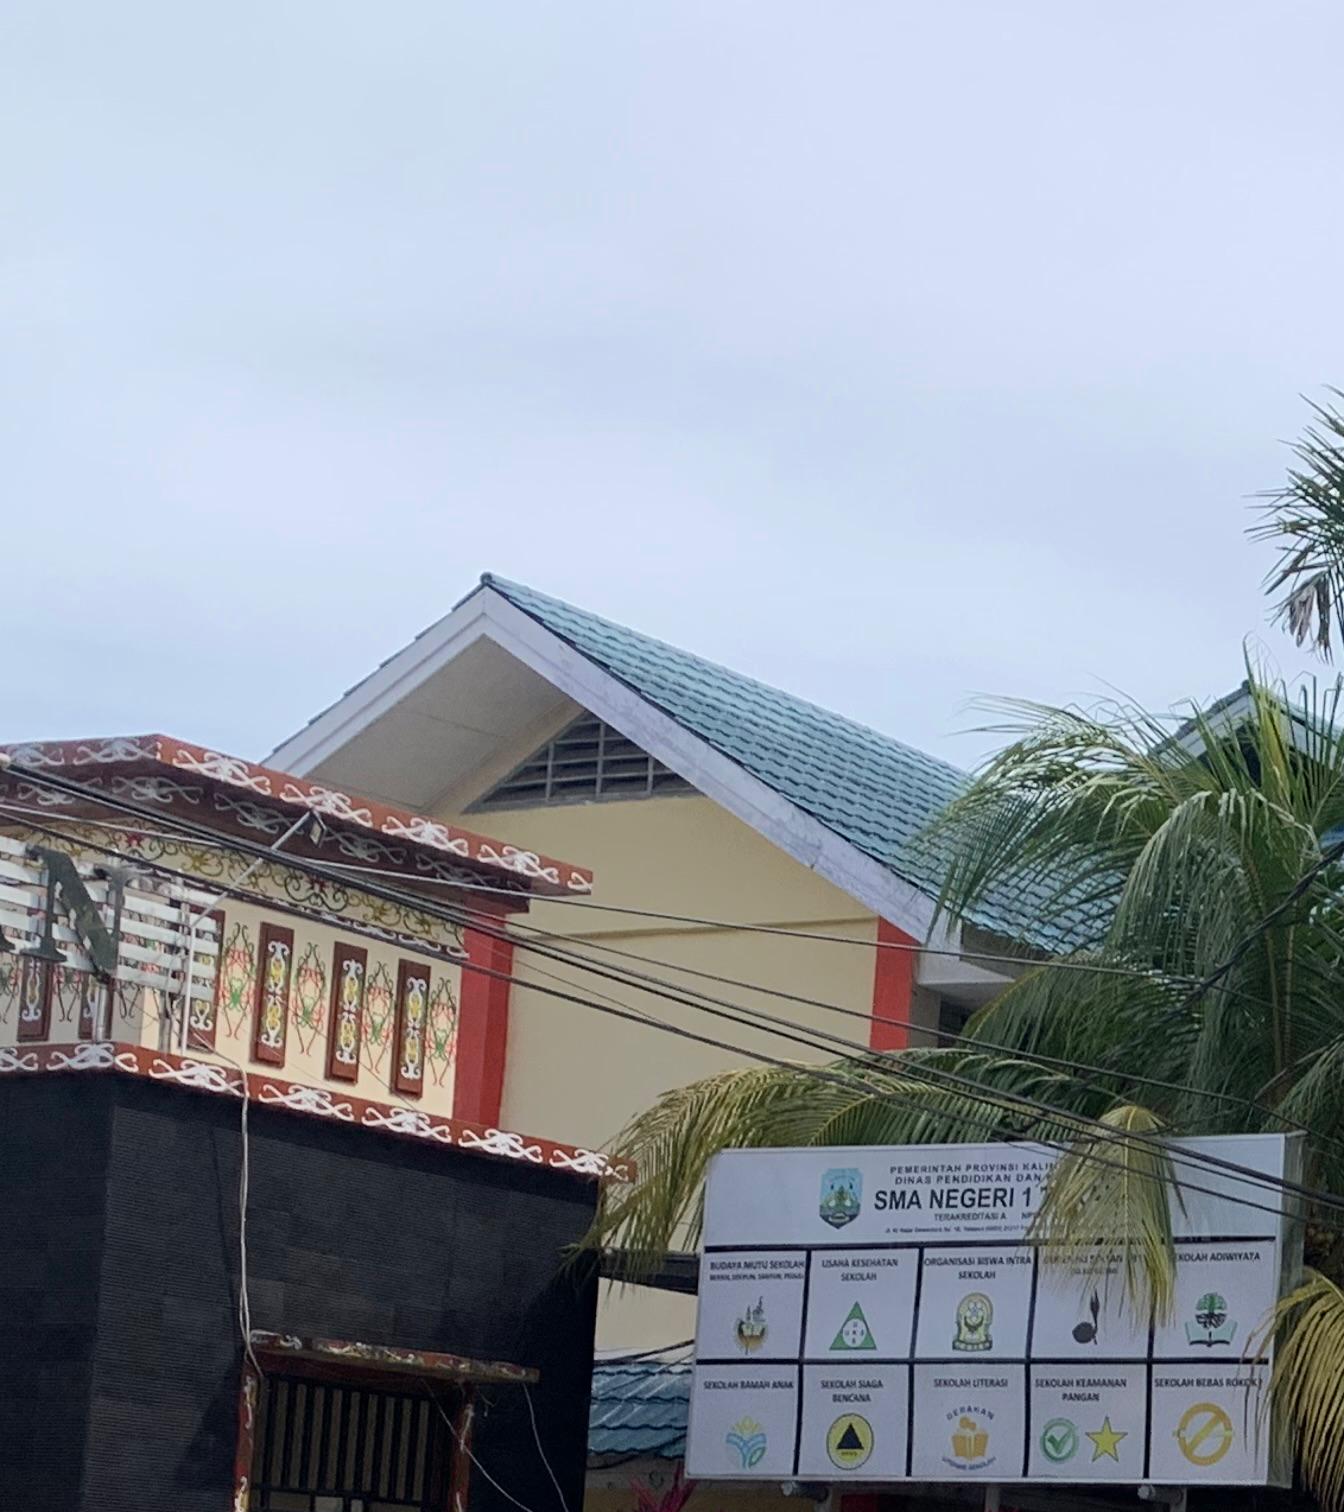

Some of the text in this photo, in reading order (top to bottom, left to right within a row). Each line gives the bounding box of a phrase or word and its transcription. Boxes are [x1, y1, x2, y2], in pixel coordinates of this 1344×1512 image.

[890, 1164, 962, 1174] PEMERINTAH
[965, 1163, 1018, 1172] PROVINSI
[895, 1174, 1041, 1185] DINAS PENDIDIKAN DAN
[874, 1187, 1031, 1210] SMA NEGERI 1
[1005, 1255, 1032, 1265] INTRA
[841, 1272, 877, 1282] SEKOLAH
[958, 1270, 996, 1280] SEKOLAH
[704, 1380, 738, 1389] SEKOLAH
[821, 1379, 857, 1389] SEKOLAH
[933, 1378, 1008, 1388] SEKOLAH LITERASI
[1035, 1378, 1127, 1388] SEKOLAH KEAMANAN
[1154, 1378, 1195, 1388] SEKOLAH
[1196, 1378, 1224, 1388] BEBAS
[1062, 1392, 1100, 1402] PANGAN
